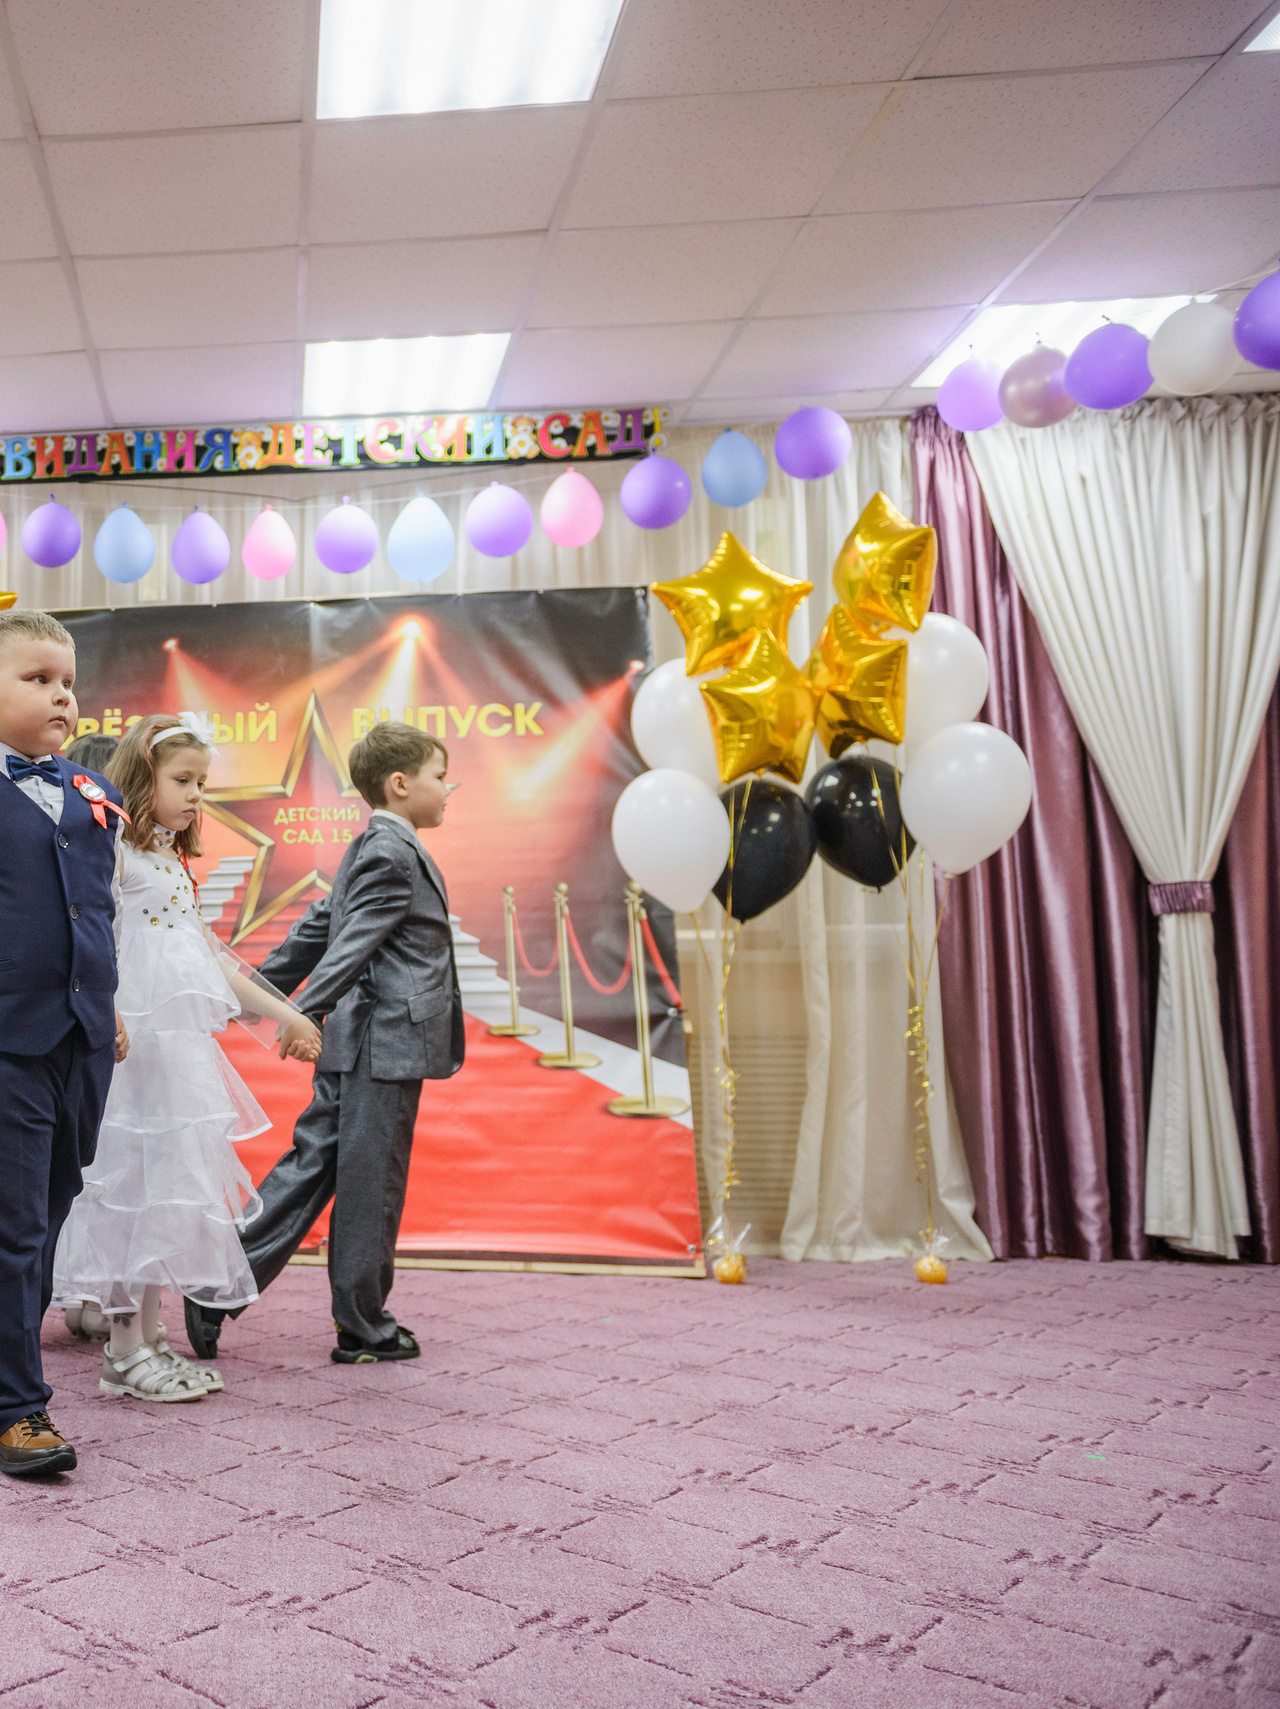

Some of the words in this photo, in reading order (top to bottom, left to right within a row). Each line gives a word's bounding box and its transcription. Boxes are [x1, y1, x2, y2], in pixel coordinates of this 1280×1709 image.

[260, 413, 510, 467] ДЕТСКИЙ
[273, 803, 361, 826] ДЕТСКИЙ
[282, 828, 325, 845] САД
[331, 828, 354, 844] 15
